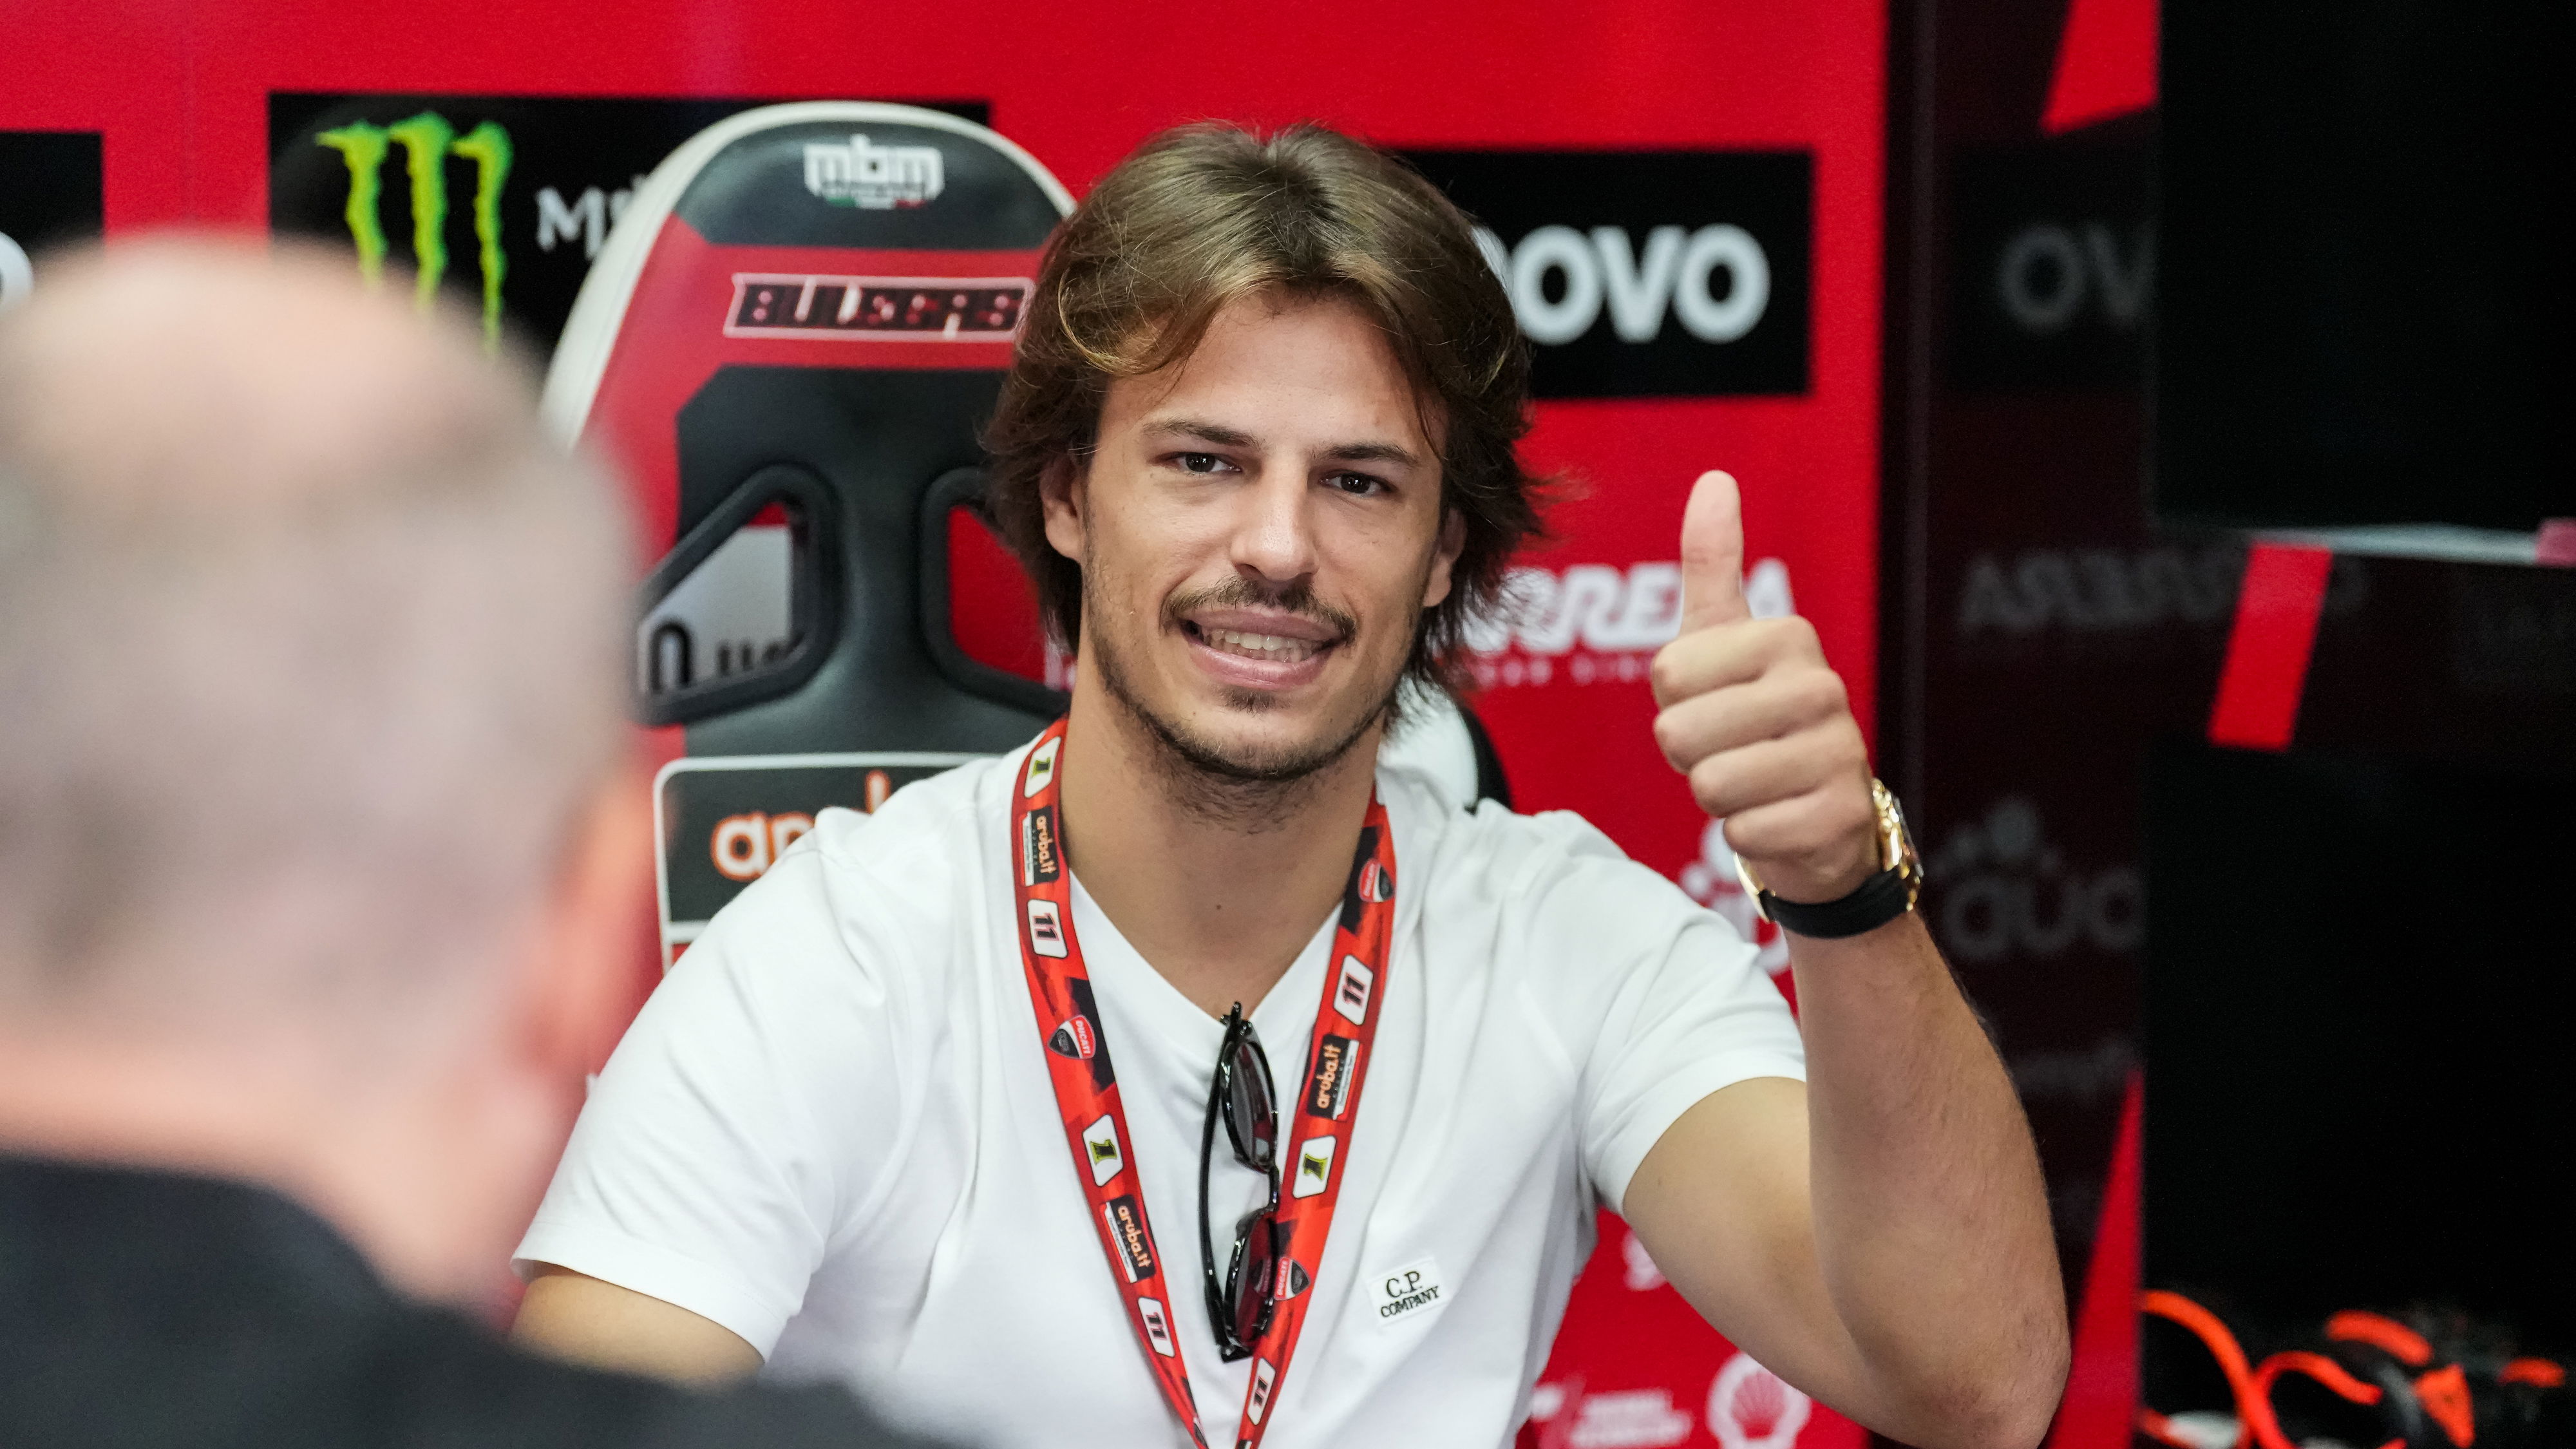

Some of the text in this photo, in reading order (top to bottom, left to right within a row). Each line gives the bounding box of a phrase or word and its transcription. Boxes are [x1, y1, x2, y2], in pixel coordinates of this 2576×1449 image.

[1032, 913, 1060, 942] 11
[1341, 972, 1366, 1007] 11
[1075, 1019, 1092, 1054] DUCATI
[1381, 1286, 1440, 1318] COMPANY
